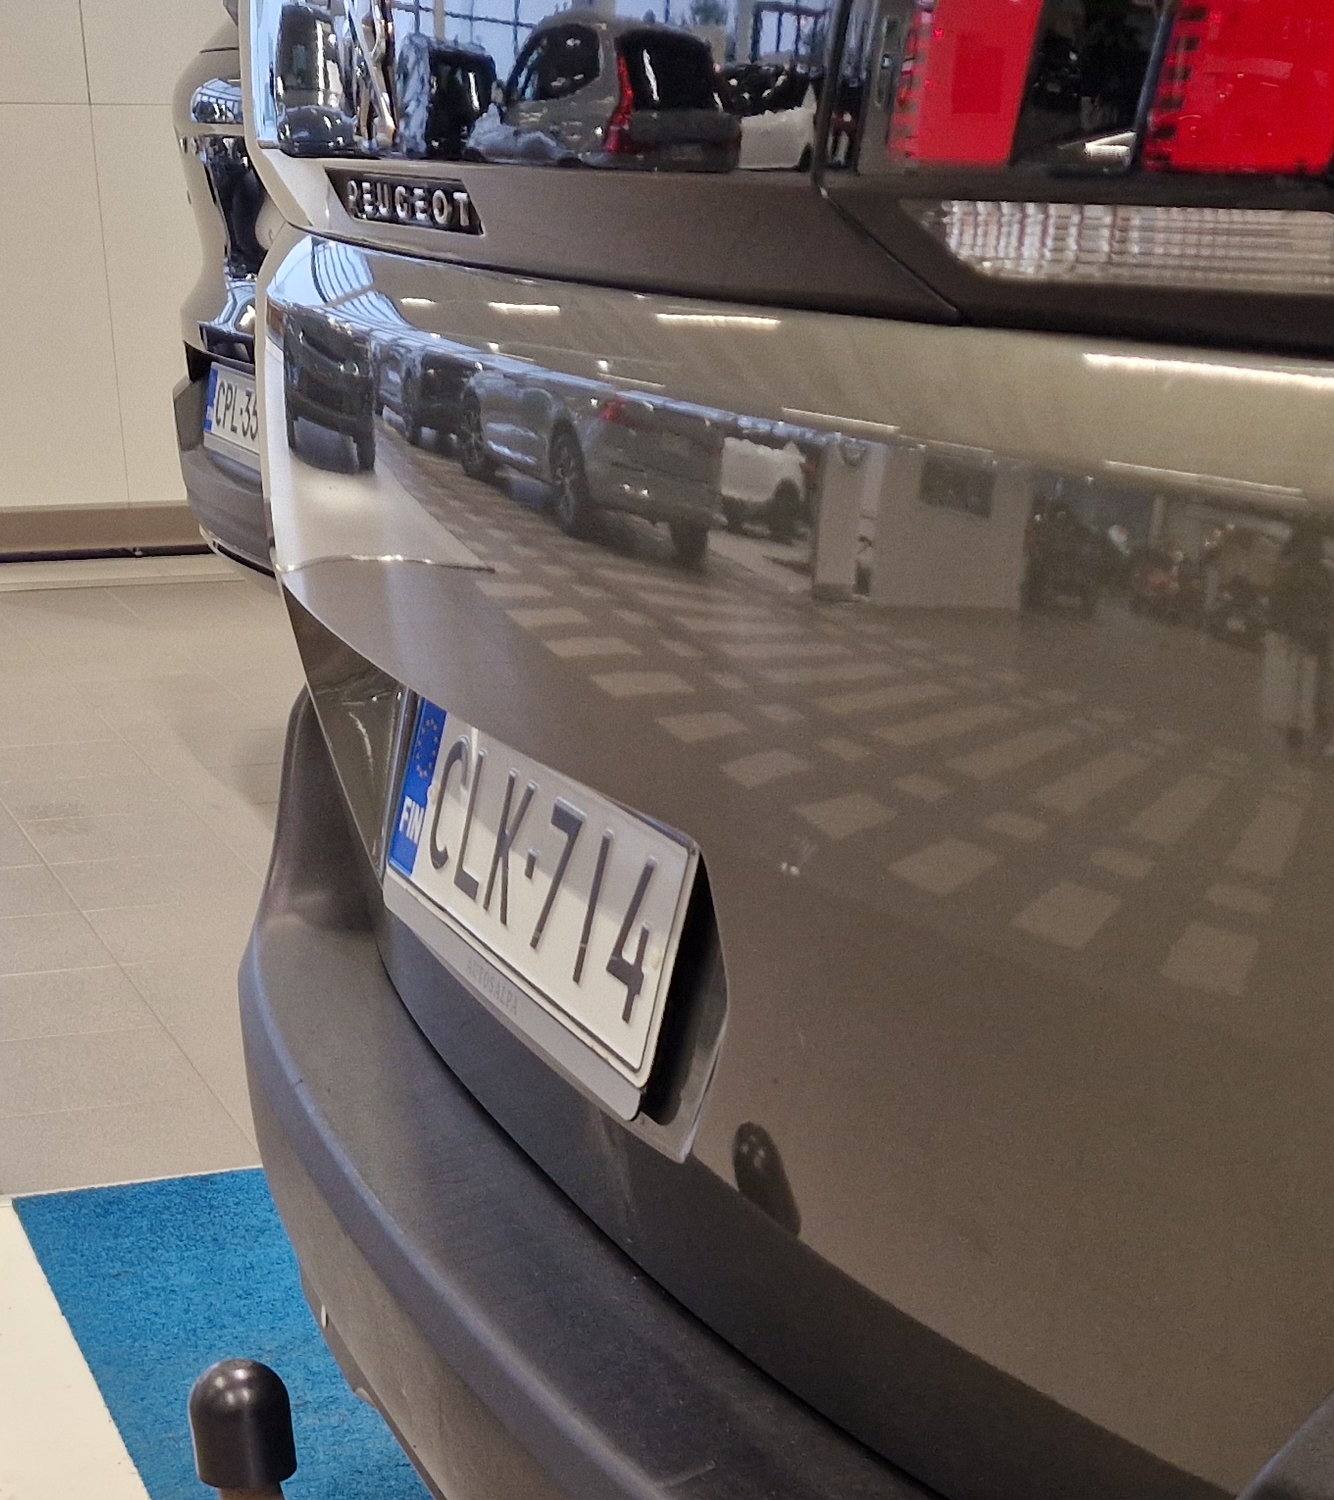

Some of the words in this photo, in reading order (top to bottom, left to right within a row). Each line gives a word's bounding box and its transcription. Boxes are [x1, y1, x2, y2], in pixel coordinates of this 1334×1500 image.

[347, 179, 470, 227] PEUGEOT
[399, 795, 424, 845] FIN
[430, 735, 657, 1024] CLK-714
